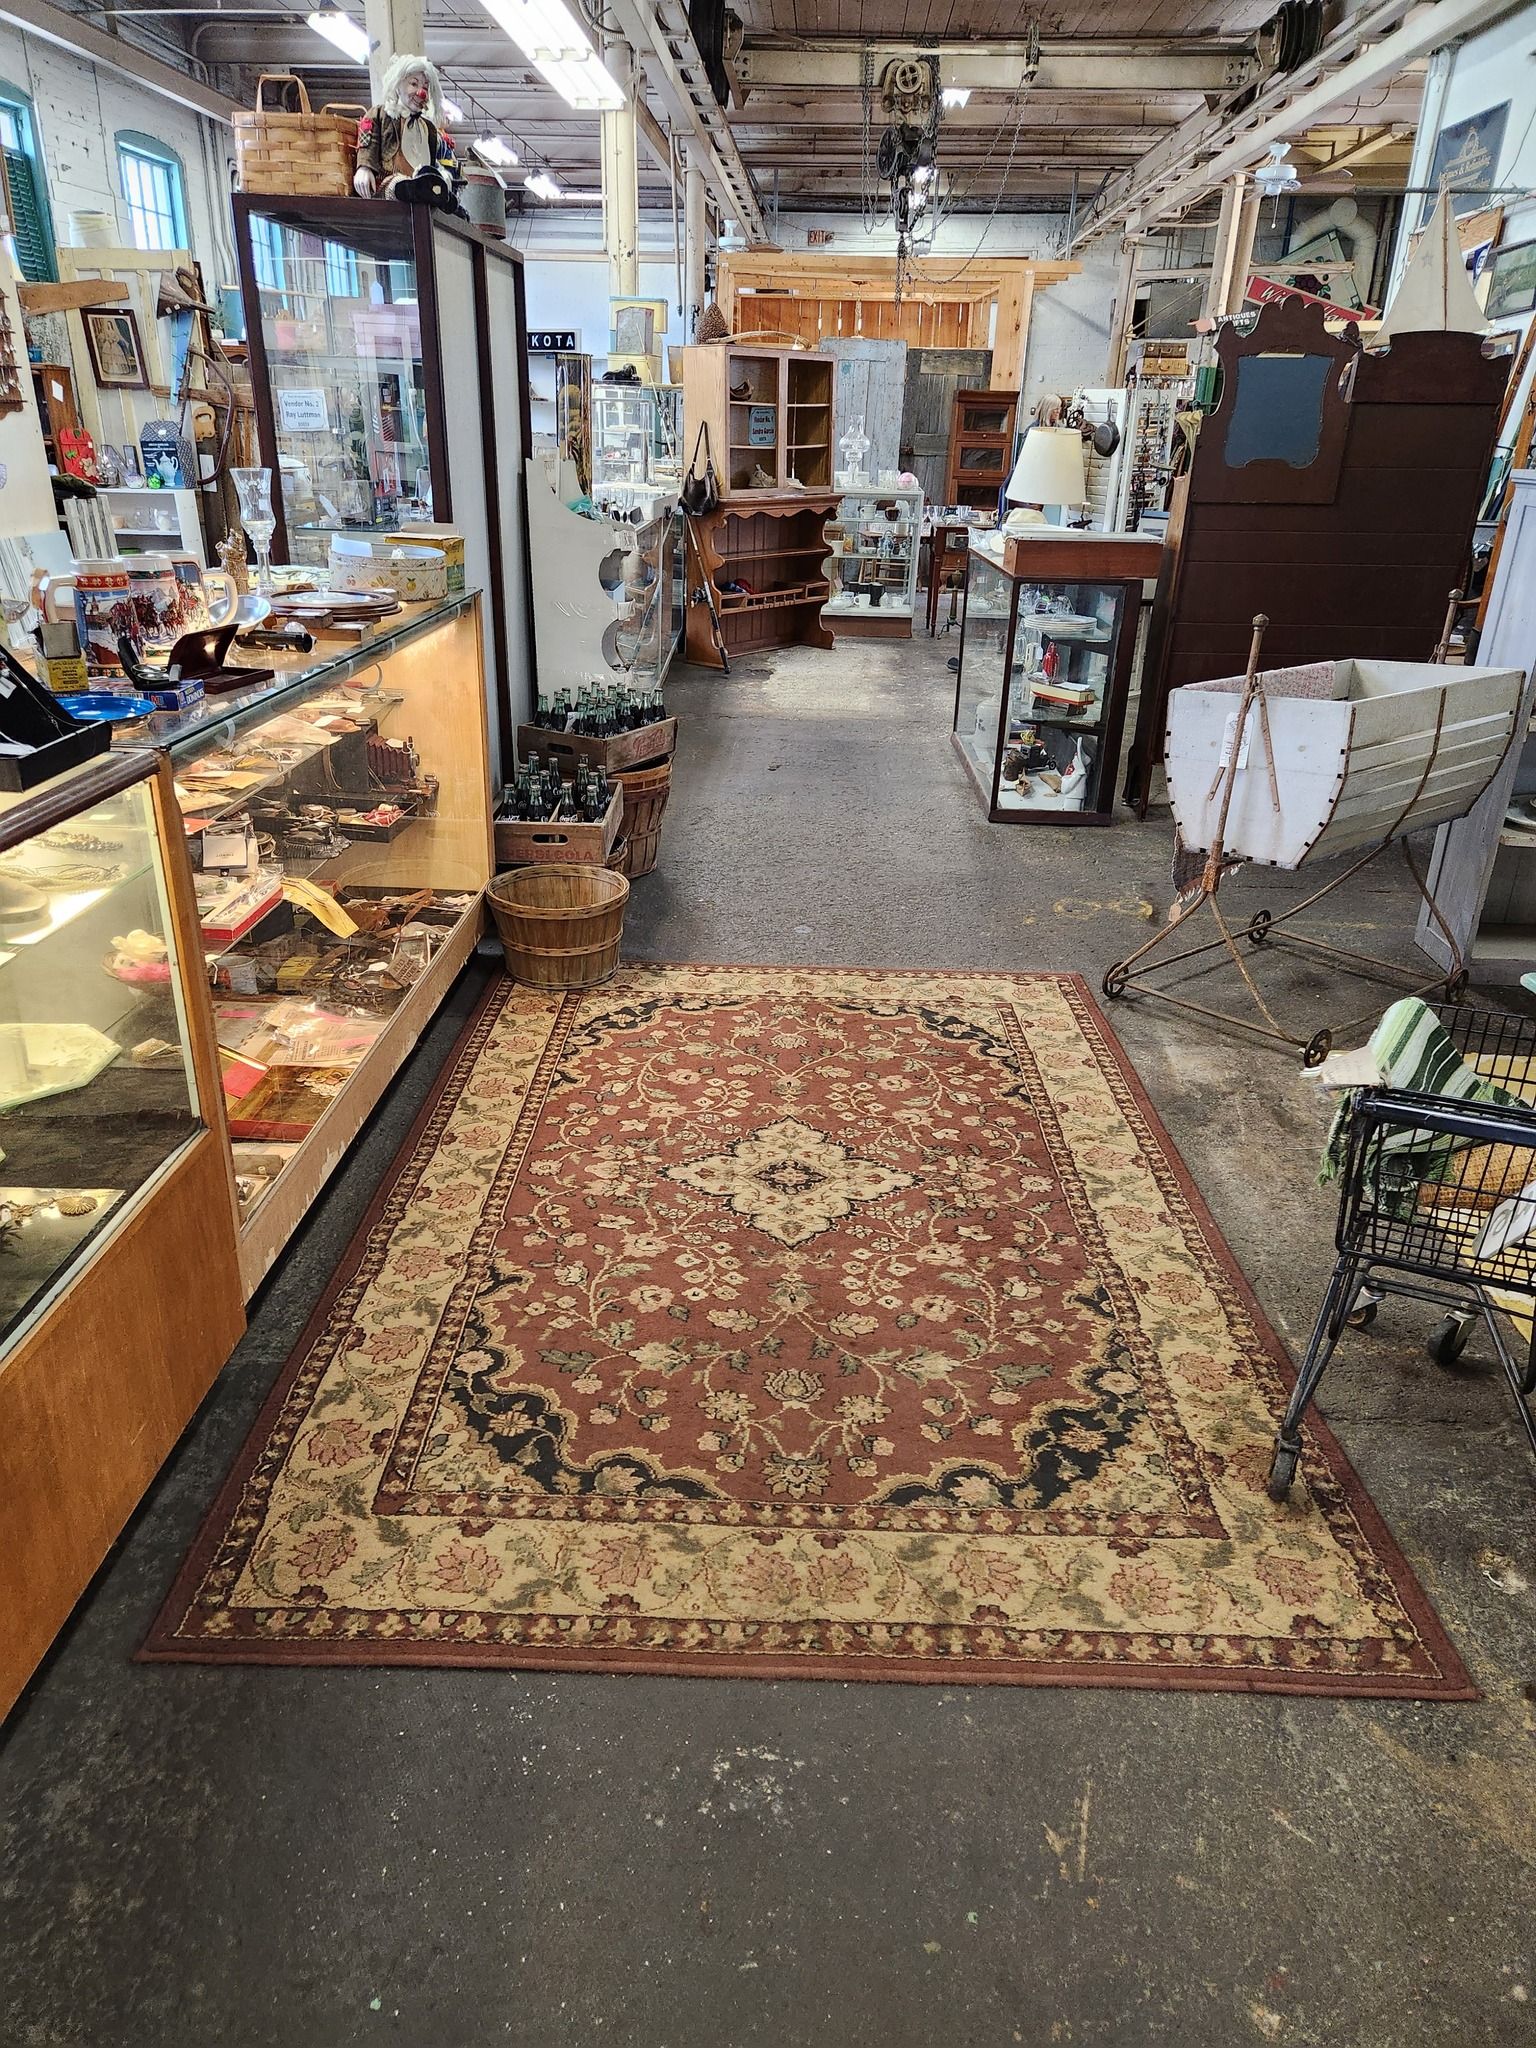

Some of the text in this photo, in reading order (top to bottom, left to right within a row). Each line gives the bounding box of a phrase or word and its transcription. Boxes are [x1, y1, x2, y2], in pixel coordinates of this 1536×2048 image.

[809, 230, 826, 244] EXIT
[1217, 311, 1257, 323] ANTIQUES
[1232, 318, 1251, 327] IFTS
[531, 334, 575, 347] KOTA
[283, 399, 304, 408] Vendor
